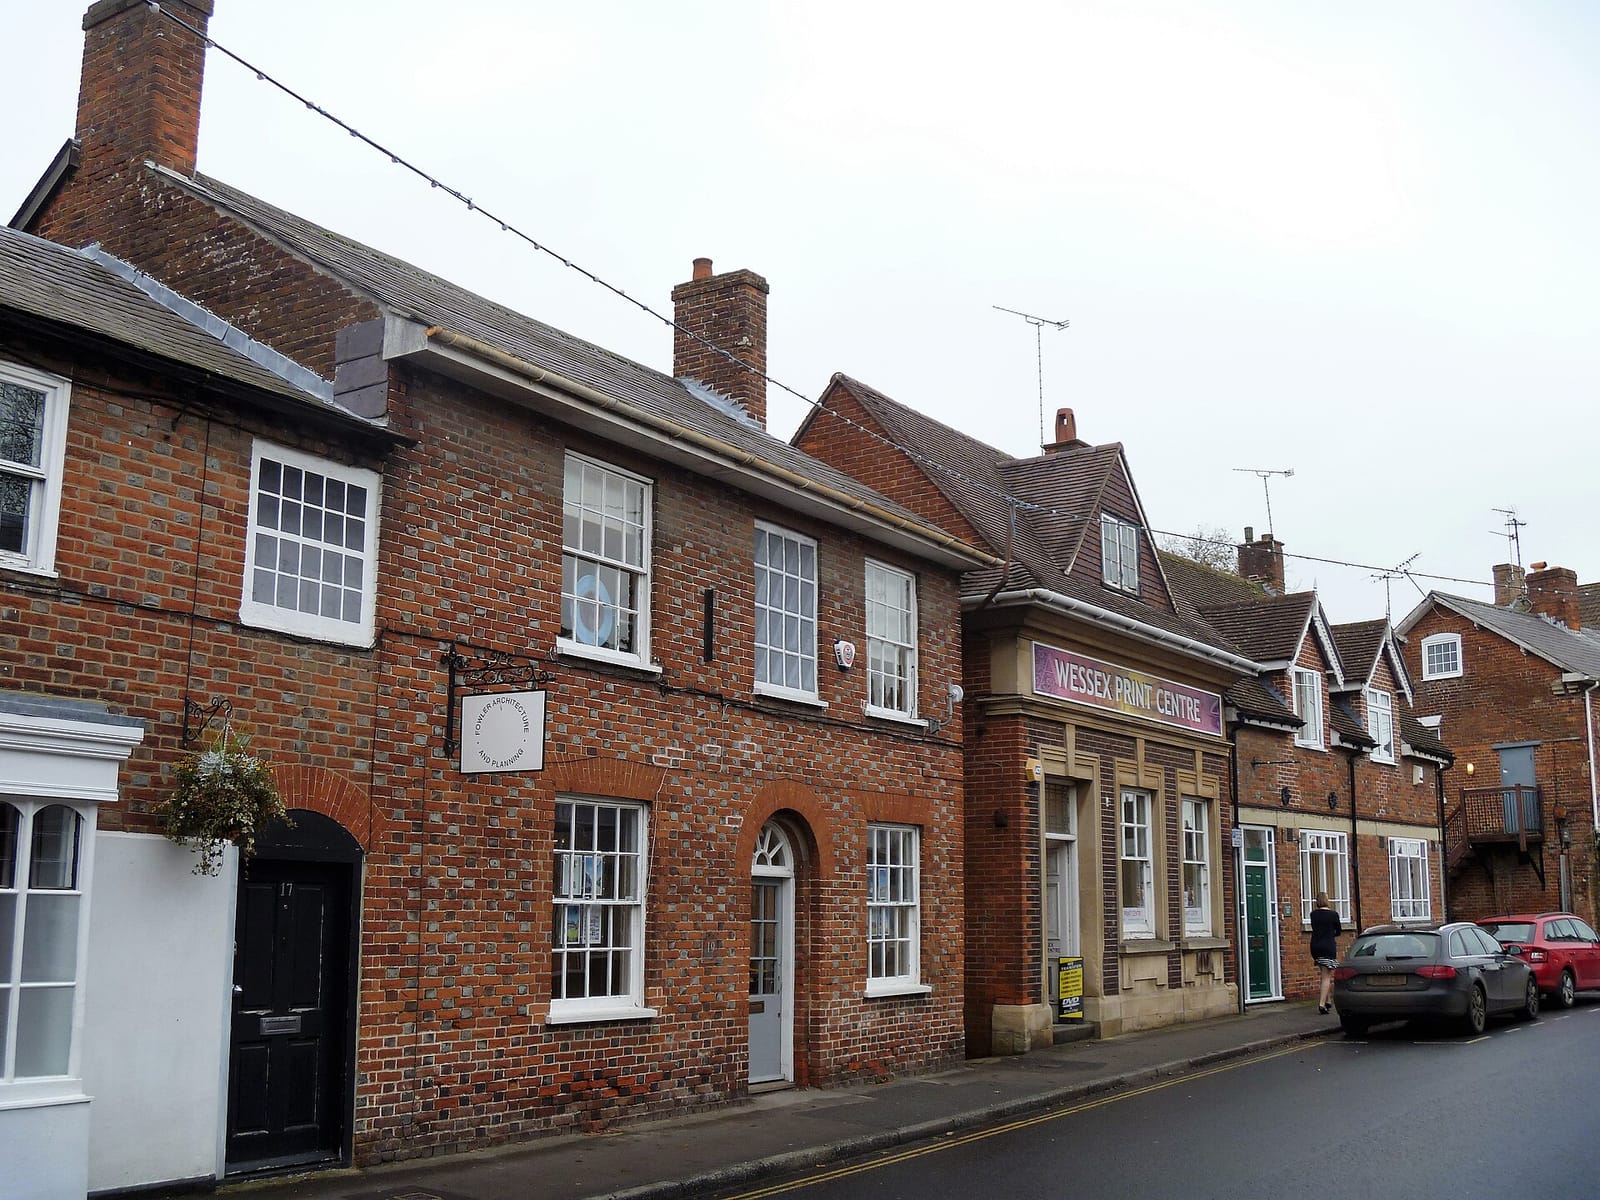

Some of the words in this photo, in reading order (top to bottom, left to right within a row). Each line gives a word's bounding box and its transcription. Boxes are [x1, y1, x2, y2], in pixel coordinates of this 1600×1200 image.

[1054, 658, 1112, 700] WESSEX
[1115, 677, 1152, 710] PRINT
[1156, 688, 1201, 723] CENTRE
[475, 703, 492, 736] FOWLER
[492, 696, 529, 733] ARCHITECTURE
[479, 750, 491, 764] AND
[491, 748, 524, 768] PLANNING
[280, 882, 293, 896] 17
